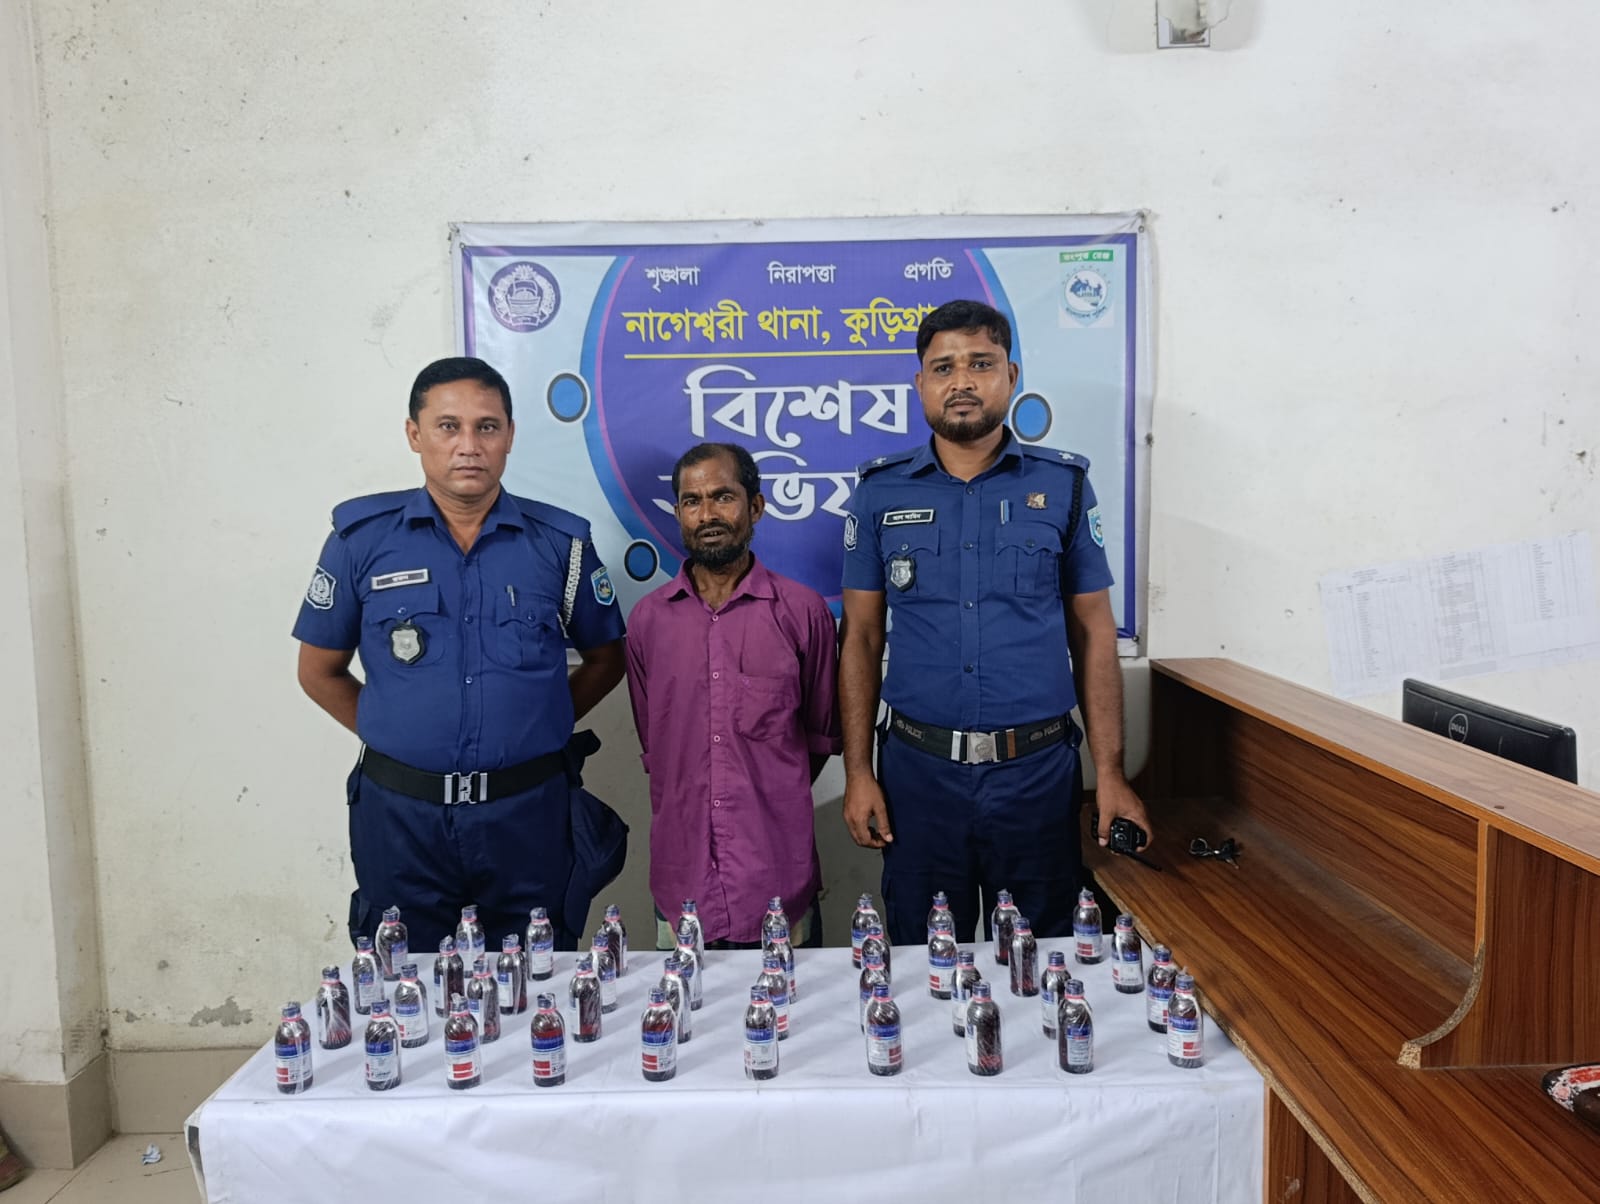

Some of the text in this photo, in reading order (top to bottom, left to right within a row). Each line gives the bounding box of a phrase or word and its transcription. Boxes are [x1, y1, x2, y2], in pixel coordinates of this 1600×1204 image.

[644, 257, 954, 293] শৃঙ্খলা নিরাপত্তা প্রগতি
[621, 297, 939, 348] নাগেশ্বরী থানা, কুড়িগ্র
[683, 364, 913, 449] বিশেষ
